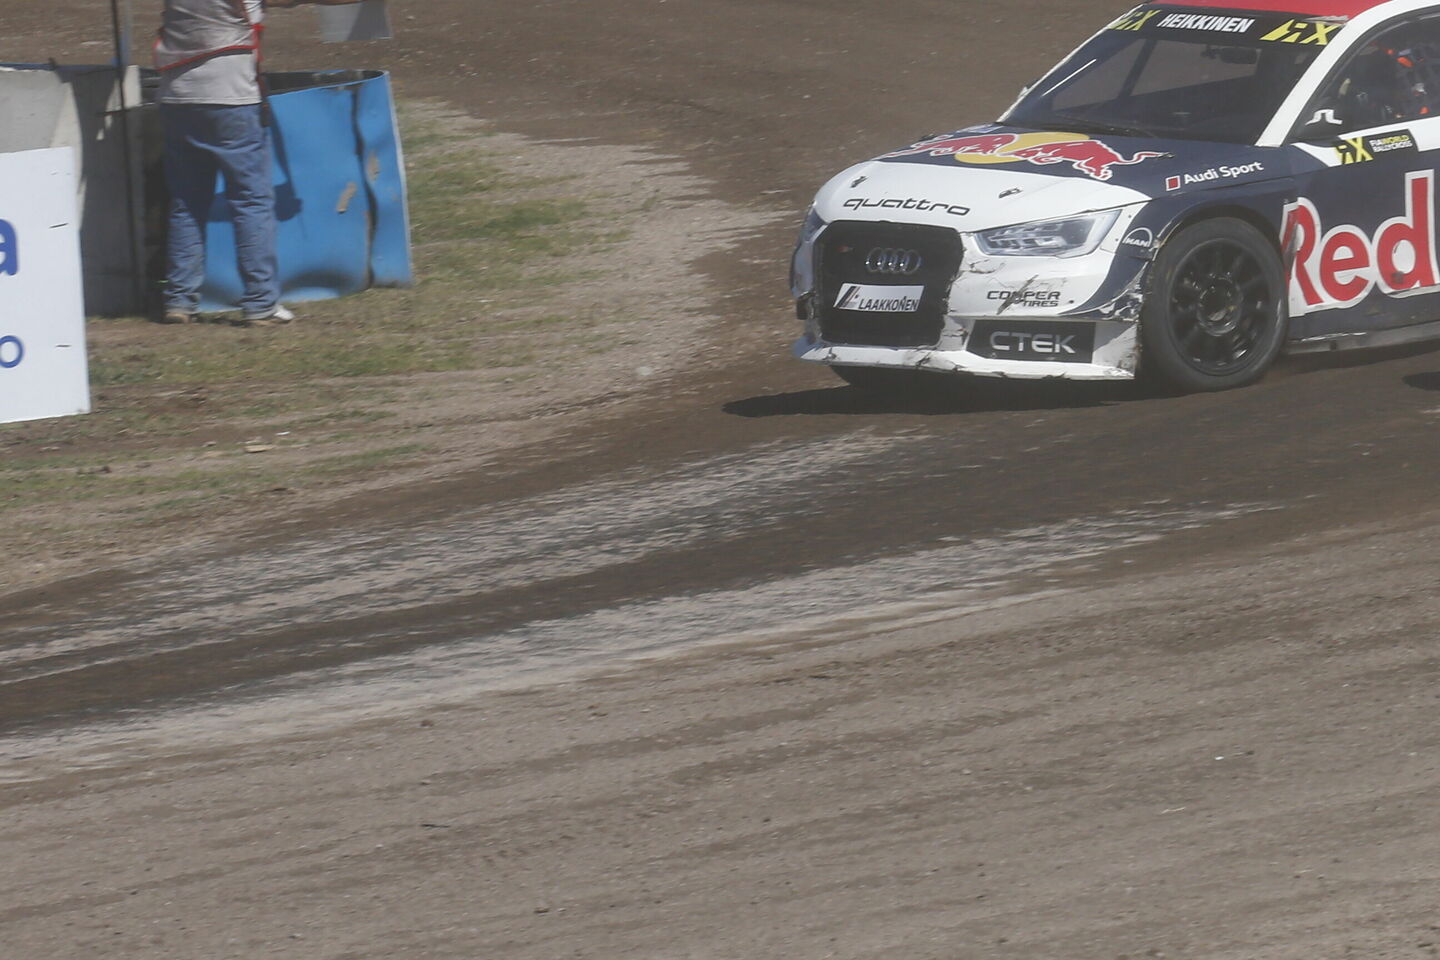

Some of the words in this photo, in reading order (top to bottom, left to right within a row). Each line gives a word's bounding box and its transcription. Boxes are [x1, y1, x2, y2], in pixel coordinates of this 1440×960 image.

[1156, 13, 1255, 34] HEIKKINEN
[1184, 168, 1220, 184] Audi
[1219, 161, 1264, 178] Sport
[843, 198, 970, 216] quattro
[1282, 175, 1437, 307] Red
[858, 298, 920, 311] LAAKKONEN
[1022, 300, 1059, 308] TIRES
[991, 330, 1076, 354] CTEK
